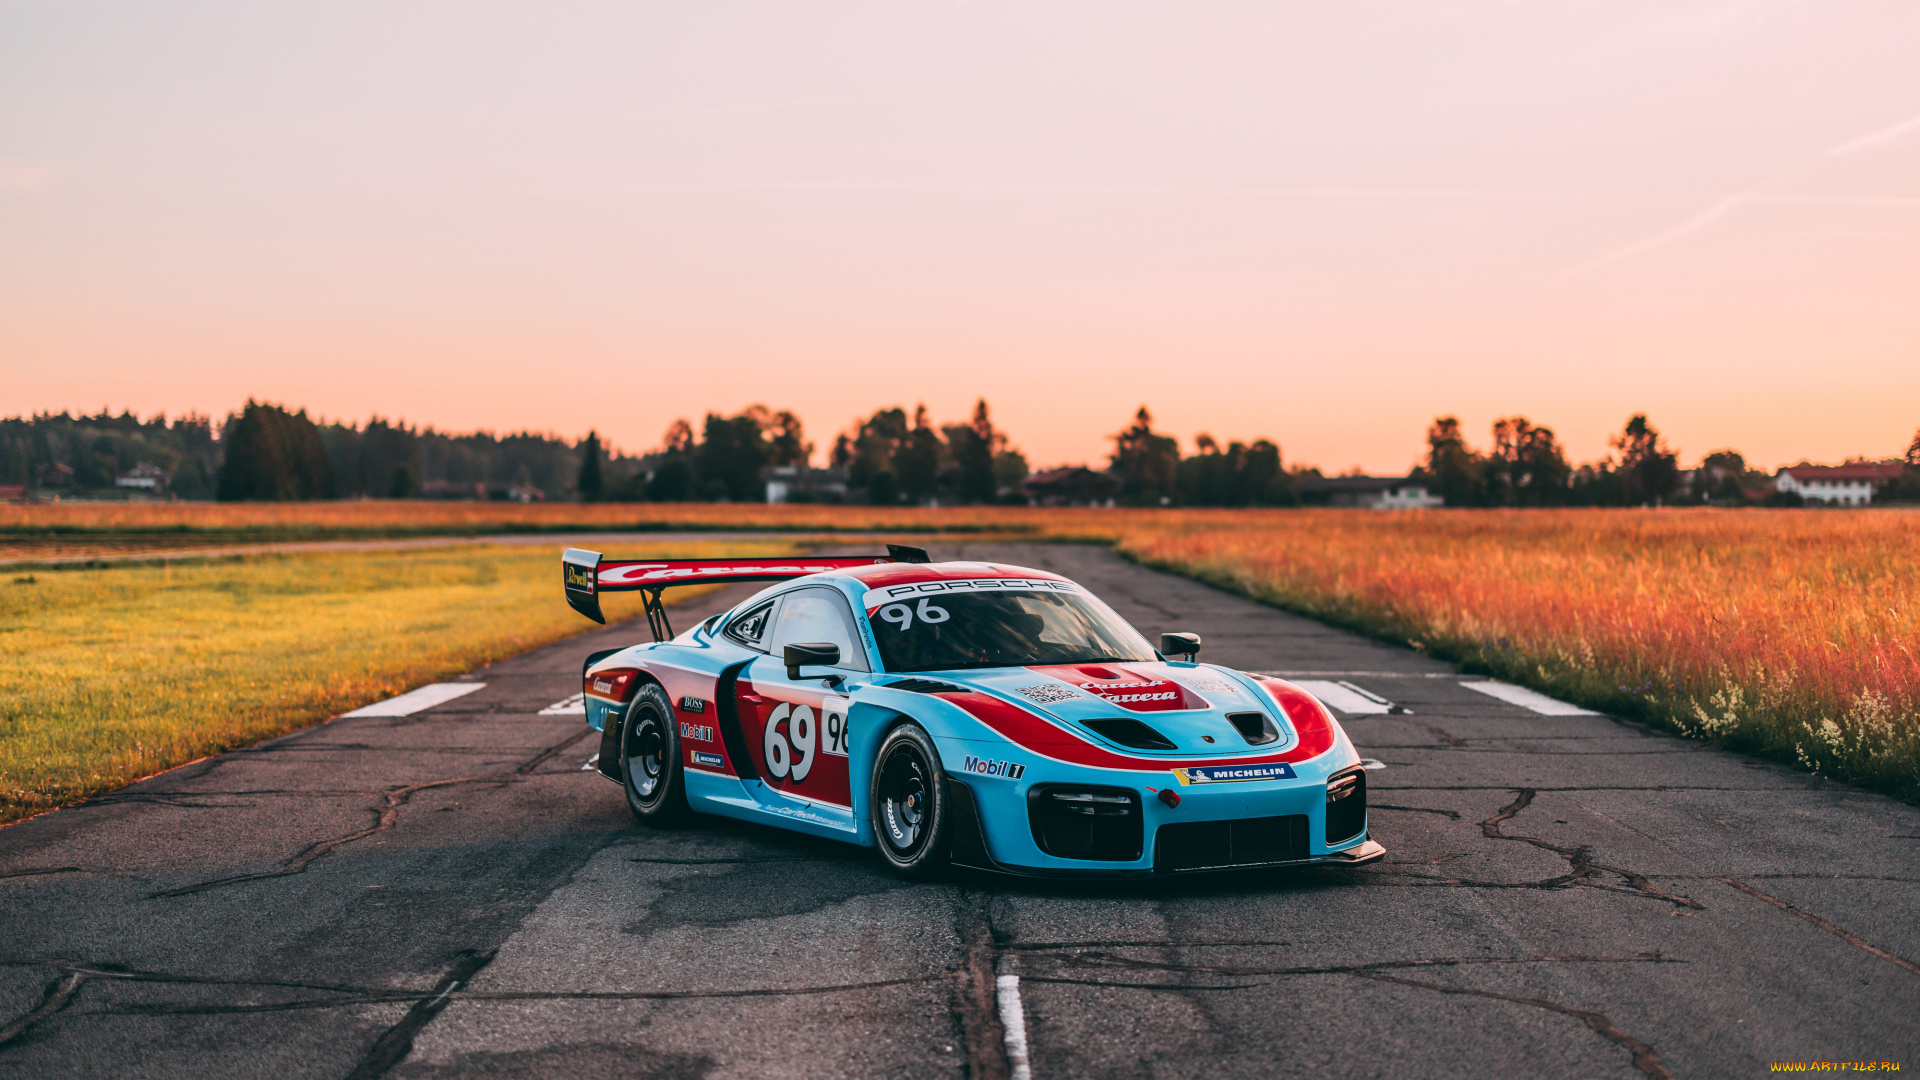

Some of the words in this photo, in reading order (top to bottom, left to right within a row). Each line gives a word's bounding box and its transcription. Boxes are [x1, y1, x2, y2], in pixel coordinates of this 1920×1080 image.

[568, 566, 587, 586] Revell
[598, 563, 838, 582] Carrer
[887, 580, 1077, 597] PORSCHE
[879, 598, 950, 631] 96
[1080, 680, 1165, 689] Carrera
[684, 697, 703, 709] BOSS
[681, 722, 704, 740] Mobil
[828, 713, 849, 753] 96
[762, 701, 816, 785] 69
[700, 755, 721, 764] MICHELIN
[963, 755, 1009, 777] Mobil
[1213, 767, 1285, 779] MICHELIN
